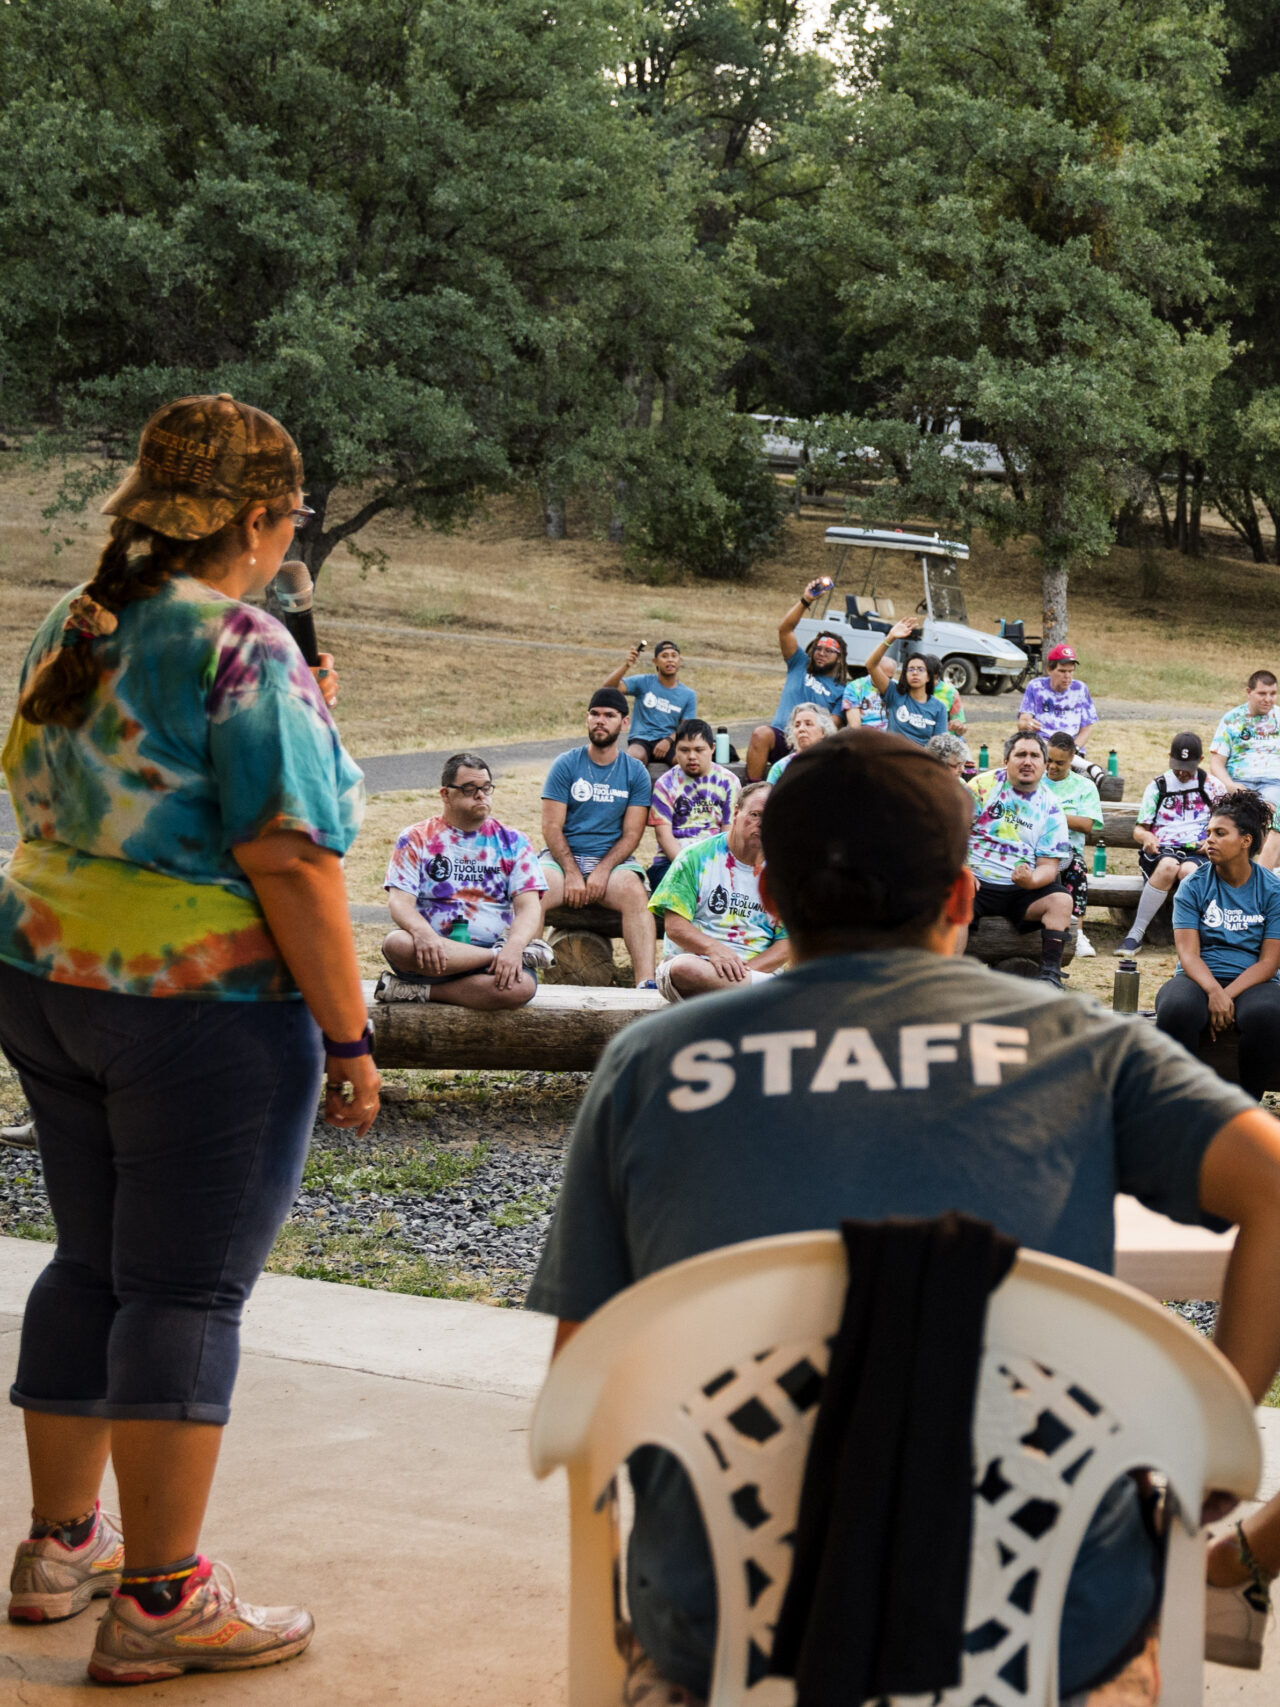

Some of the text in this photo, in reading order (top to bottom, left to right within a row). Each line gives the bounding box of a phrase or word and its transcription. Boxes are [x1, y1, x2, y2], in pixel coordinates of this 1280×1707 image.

[1181, 748, 1189, 759] S
[454, 864, 501, 874] TUOLUMNE
[454, 873, 484, 882] TRAILS
[1223, 921, 1249, 931] TRAILS
[668, 1022, 1030, 1113] STAFF
